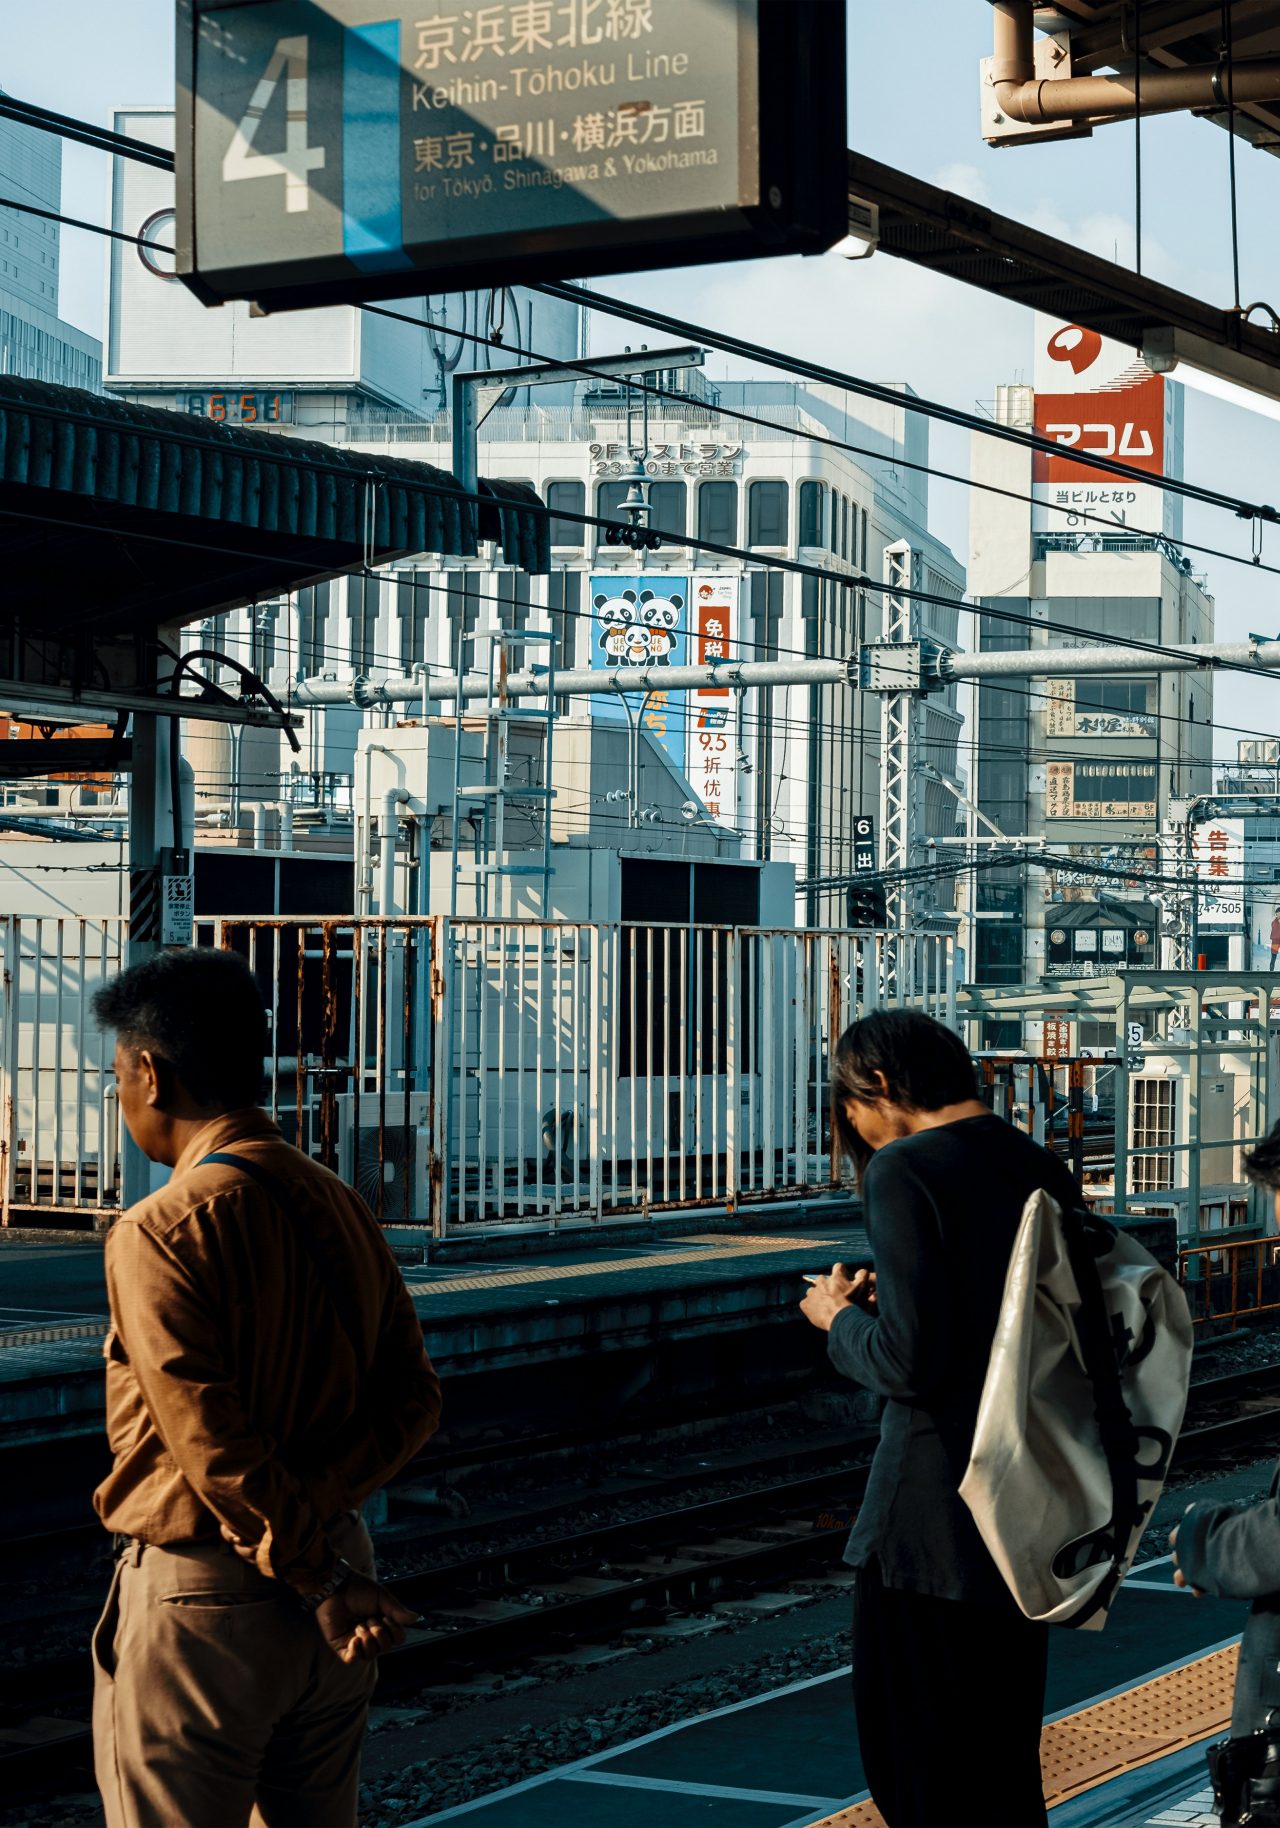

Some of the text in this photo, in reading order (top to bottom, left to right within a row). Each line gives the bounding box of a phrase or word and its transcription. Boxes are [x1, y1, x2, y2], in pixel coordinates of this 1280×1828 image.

[413, 0, 653, 70] 京浜東北線
[412, 50, 689, 112] Keihin-Tōhoku Line
[222, 35, 326, 214] 4
[413, 99, 706, 173] 東京・品川・横浜方面
[414, 184, 436, 201] for
[504, 161, 599, 190] Shinagawa
[604, 157, 618, 178] &
[622, 147, 718, 175] Yokohama
[208, 394, 280, 422] 6:51
[589, 443, 741, 460] 9F ストラン
[1045, 423, 1154, 458] アコム
[596, 461, 734, 476] 23:0まで営業
[1056, 489, 1137, 504] 当ビルとなり
[698, 733, 727, 752] 9.5
